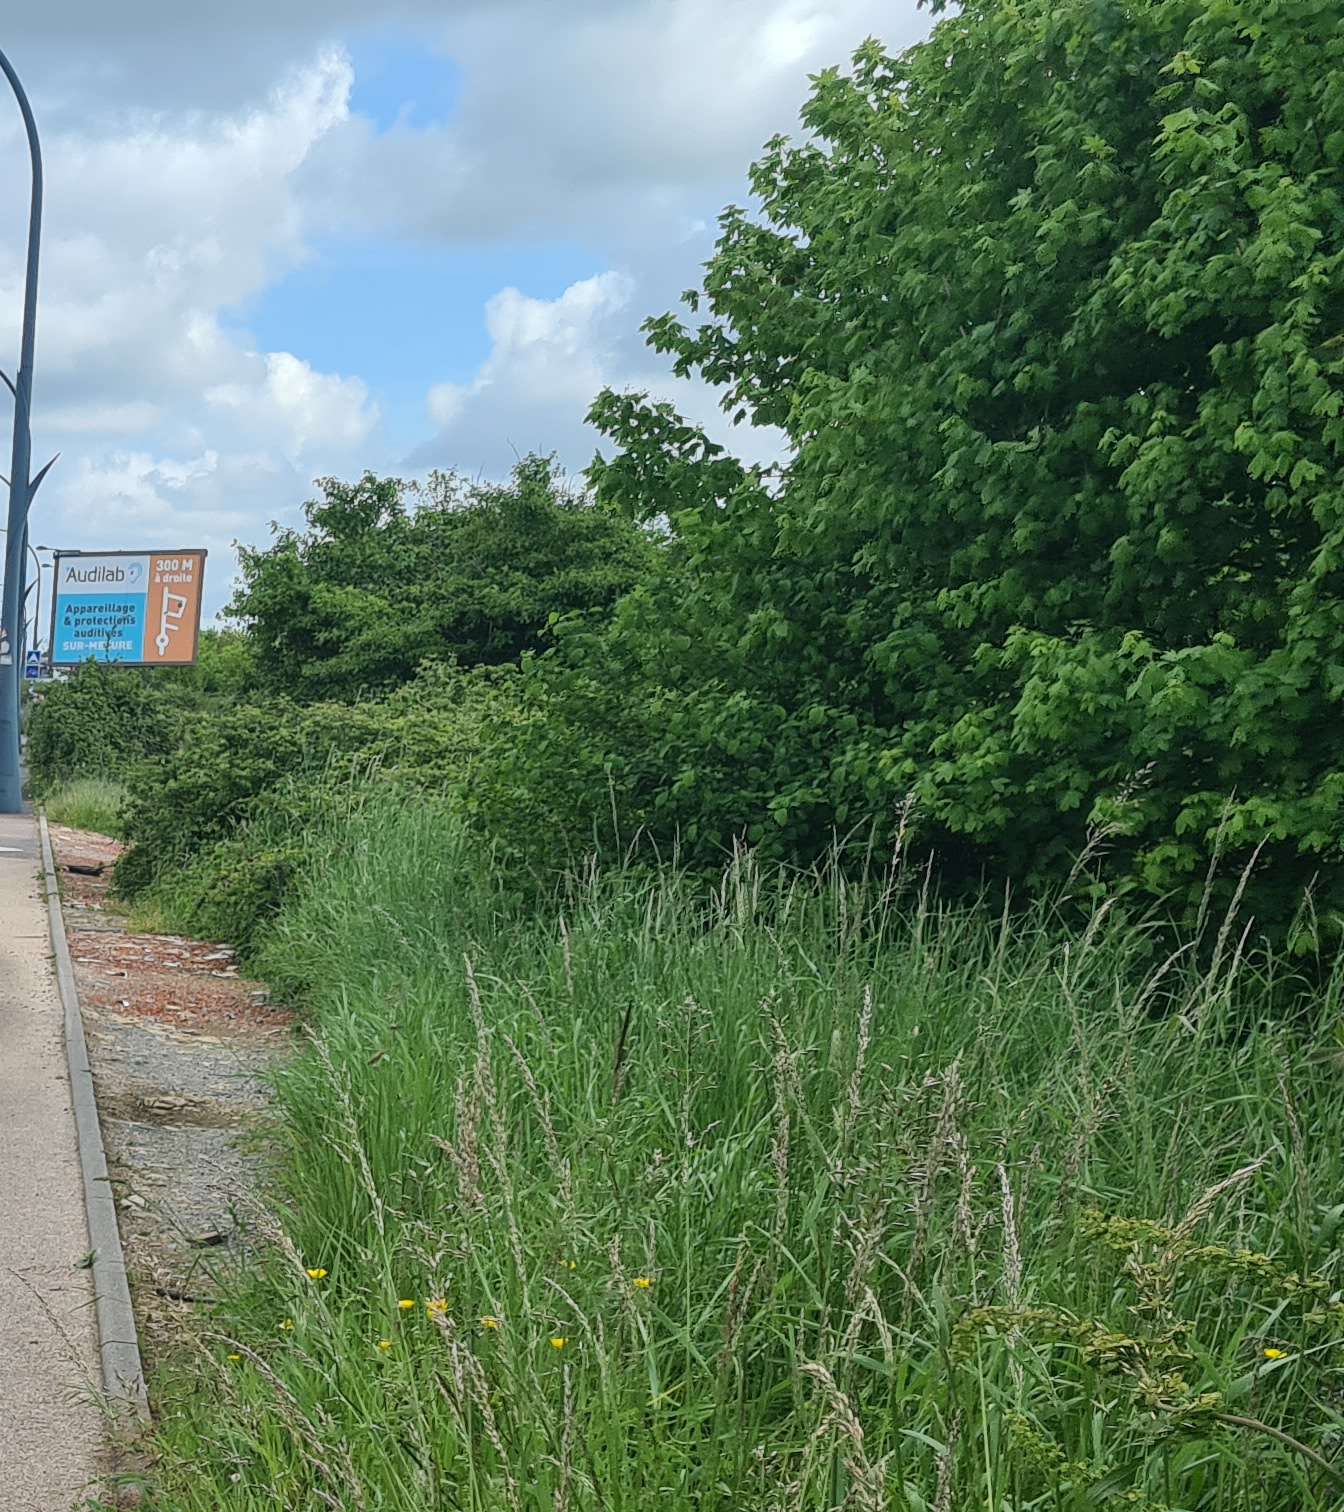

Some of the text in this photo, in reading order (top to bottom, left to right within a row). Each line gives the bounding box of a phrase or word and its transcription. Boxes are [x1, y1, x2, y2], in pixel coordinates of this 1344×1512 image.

[157, 559, 179, 571] 300
[65, 566, 125, 583] Audilab
[162, 572, 193, 583] droite
[65, 604, 136, 615] Appareillage
[74, 615, 136, 627] protections
